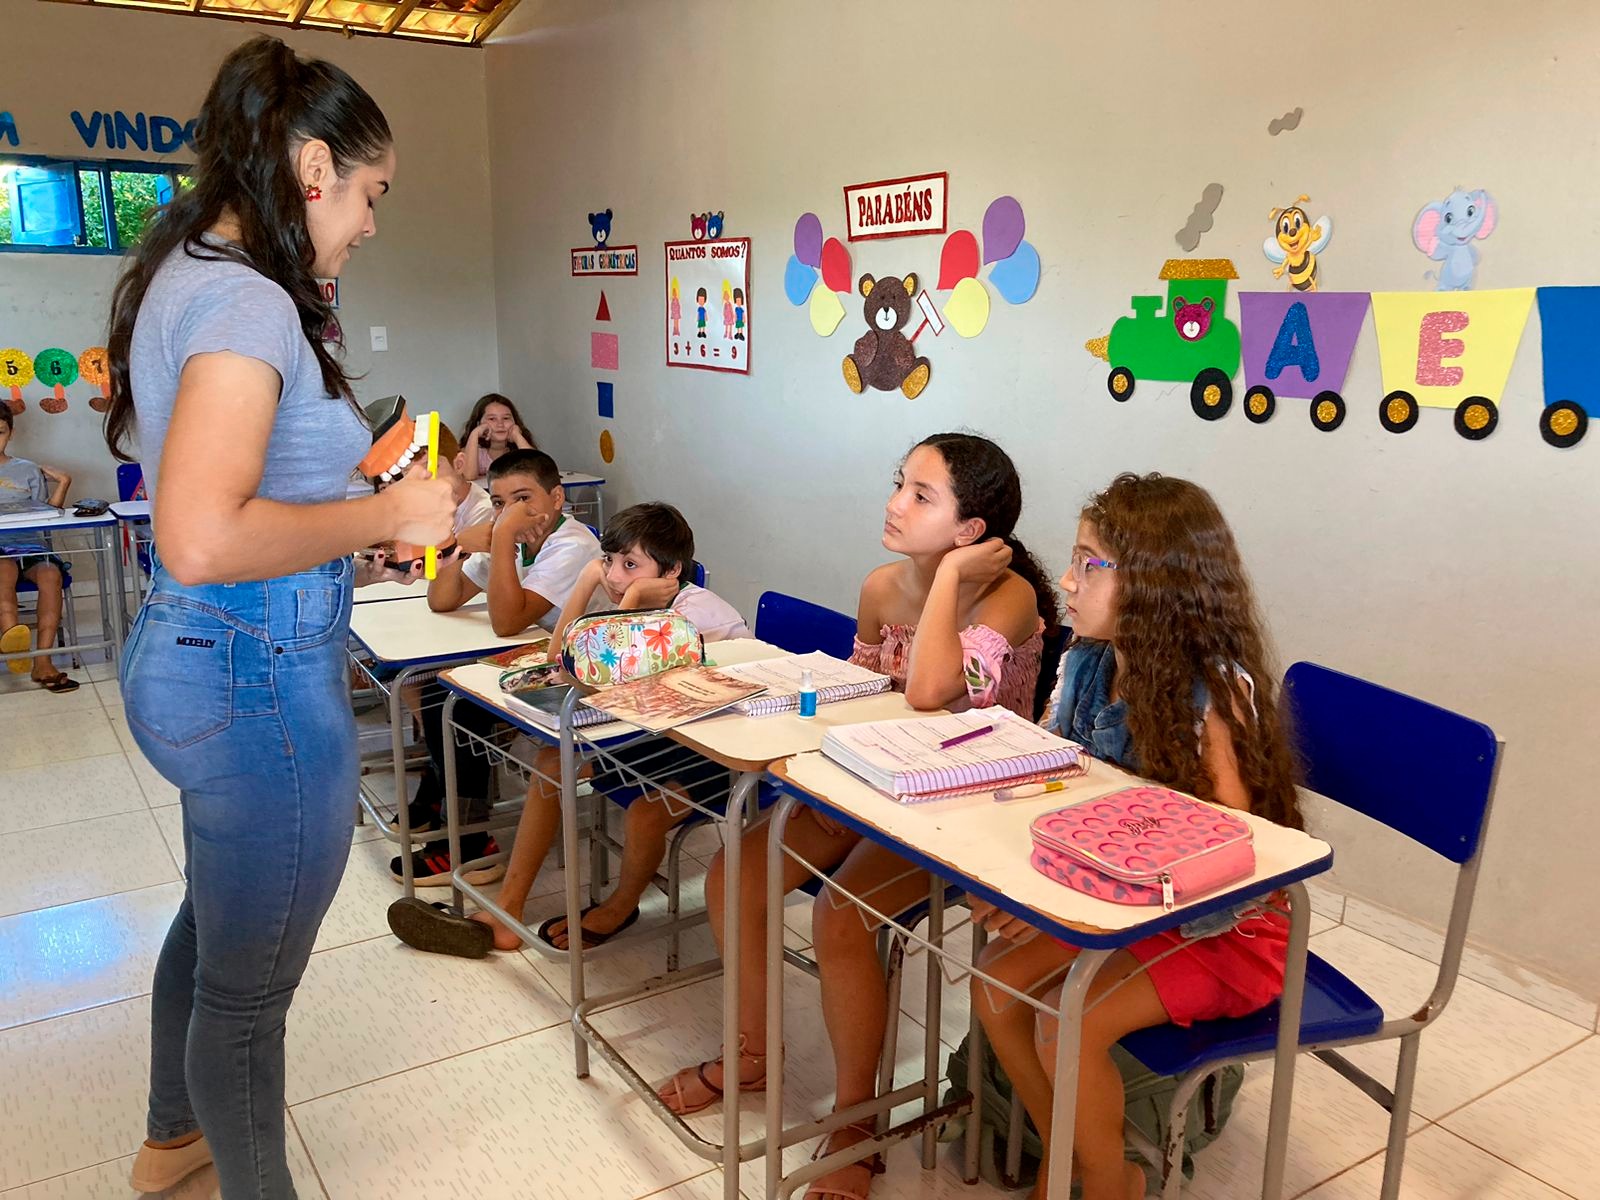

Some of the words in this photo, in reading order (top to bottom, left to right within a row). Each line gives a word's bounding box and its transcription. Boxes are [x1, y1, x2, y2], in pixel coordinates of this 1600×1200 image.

[858, 185, 932, 227] PARABÉNS
[669, 246, 706, 260] QUANTOS
[711, 241, 746, 259] SOMOS?
[673, 342, 679, 355] 3
[700, 344, 706, 357] 6
[731, 346, 737, 359] 9
[1264, 302, 1320, 383] A
[1415, 311, 1470, 386] E
[5, 360, 19, 376] 5
[50, 360, 62, 376] 6
[91, 359, 103, 374] 7
